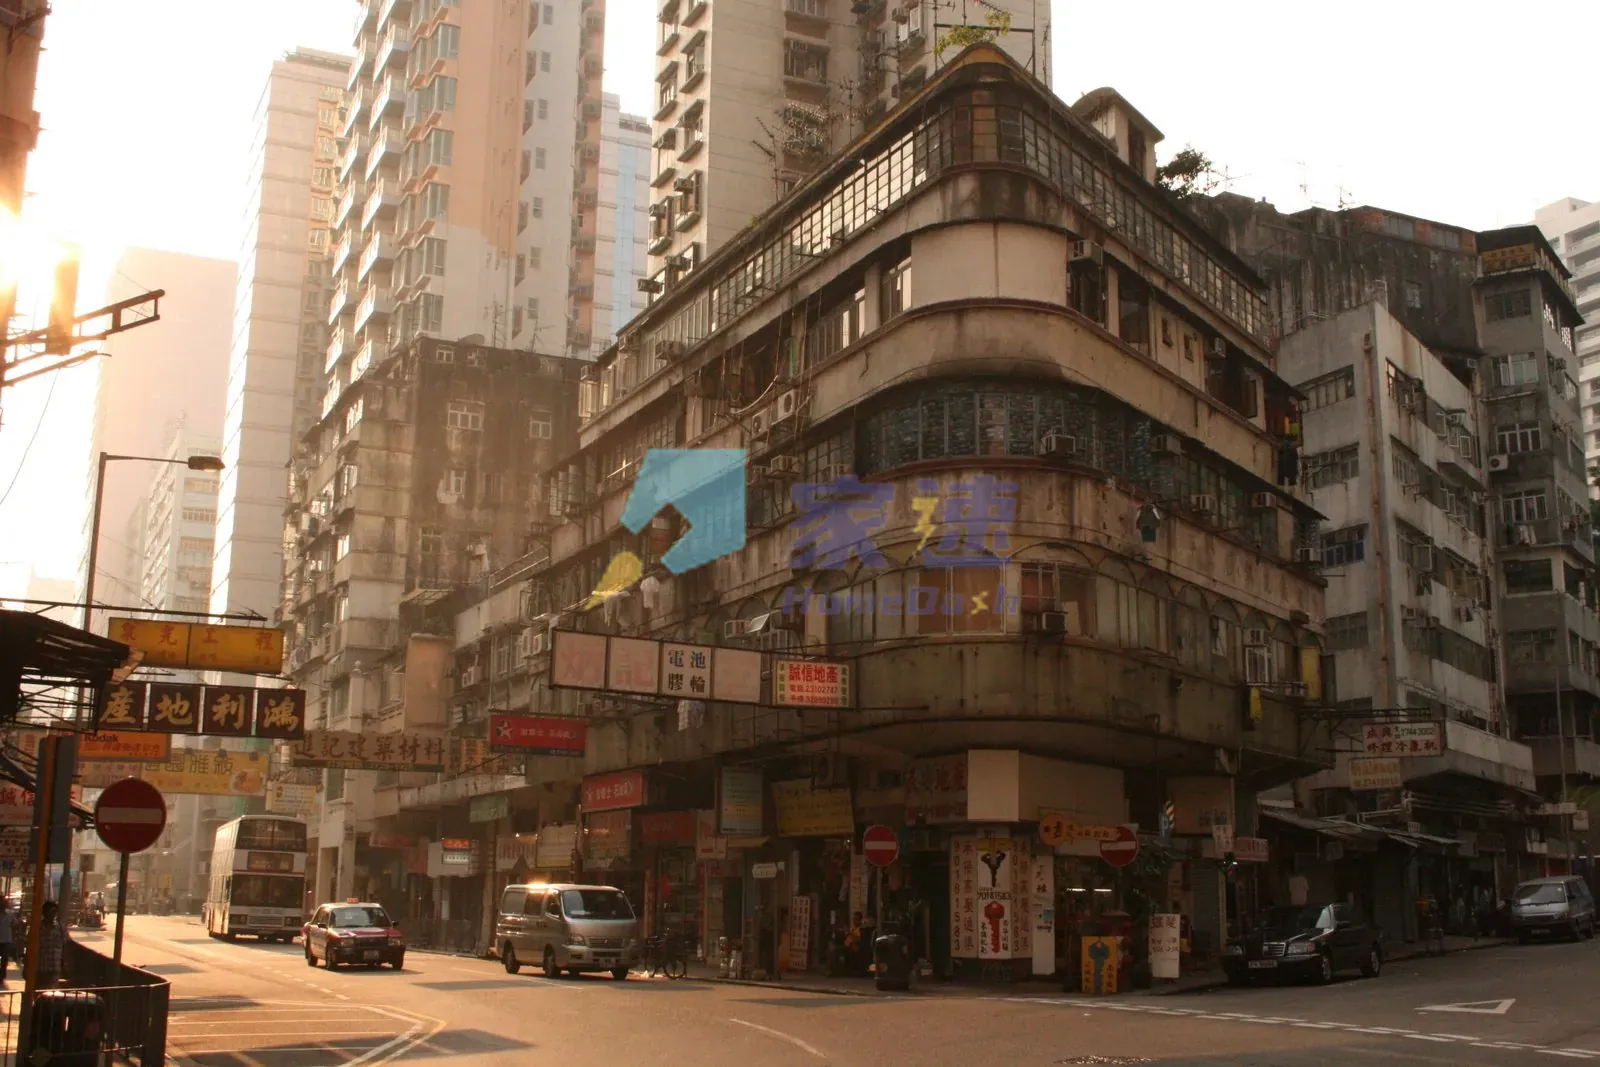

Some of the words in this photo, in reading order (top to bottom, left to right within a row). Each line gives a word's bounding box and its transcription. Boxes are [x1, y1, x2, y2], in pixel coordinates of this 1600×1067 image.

[667, 650, 707, 669] 電池
[667, 673, 706, 693] 膠輪
[788, 663, 839, 684] 誠信地產
[100, 686, 300, 732] 鴻利地產
